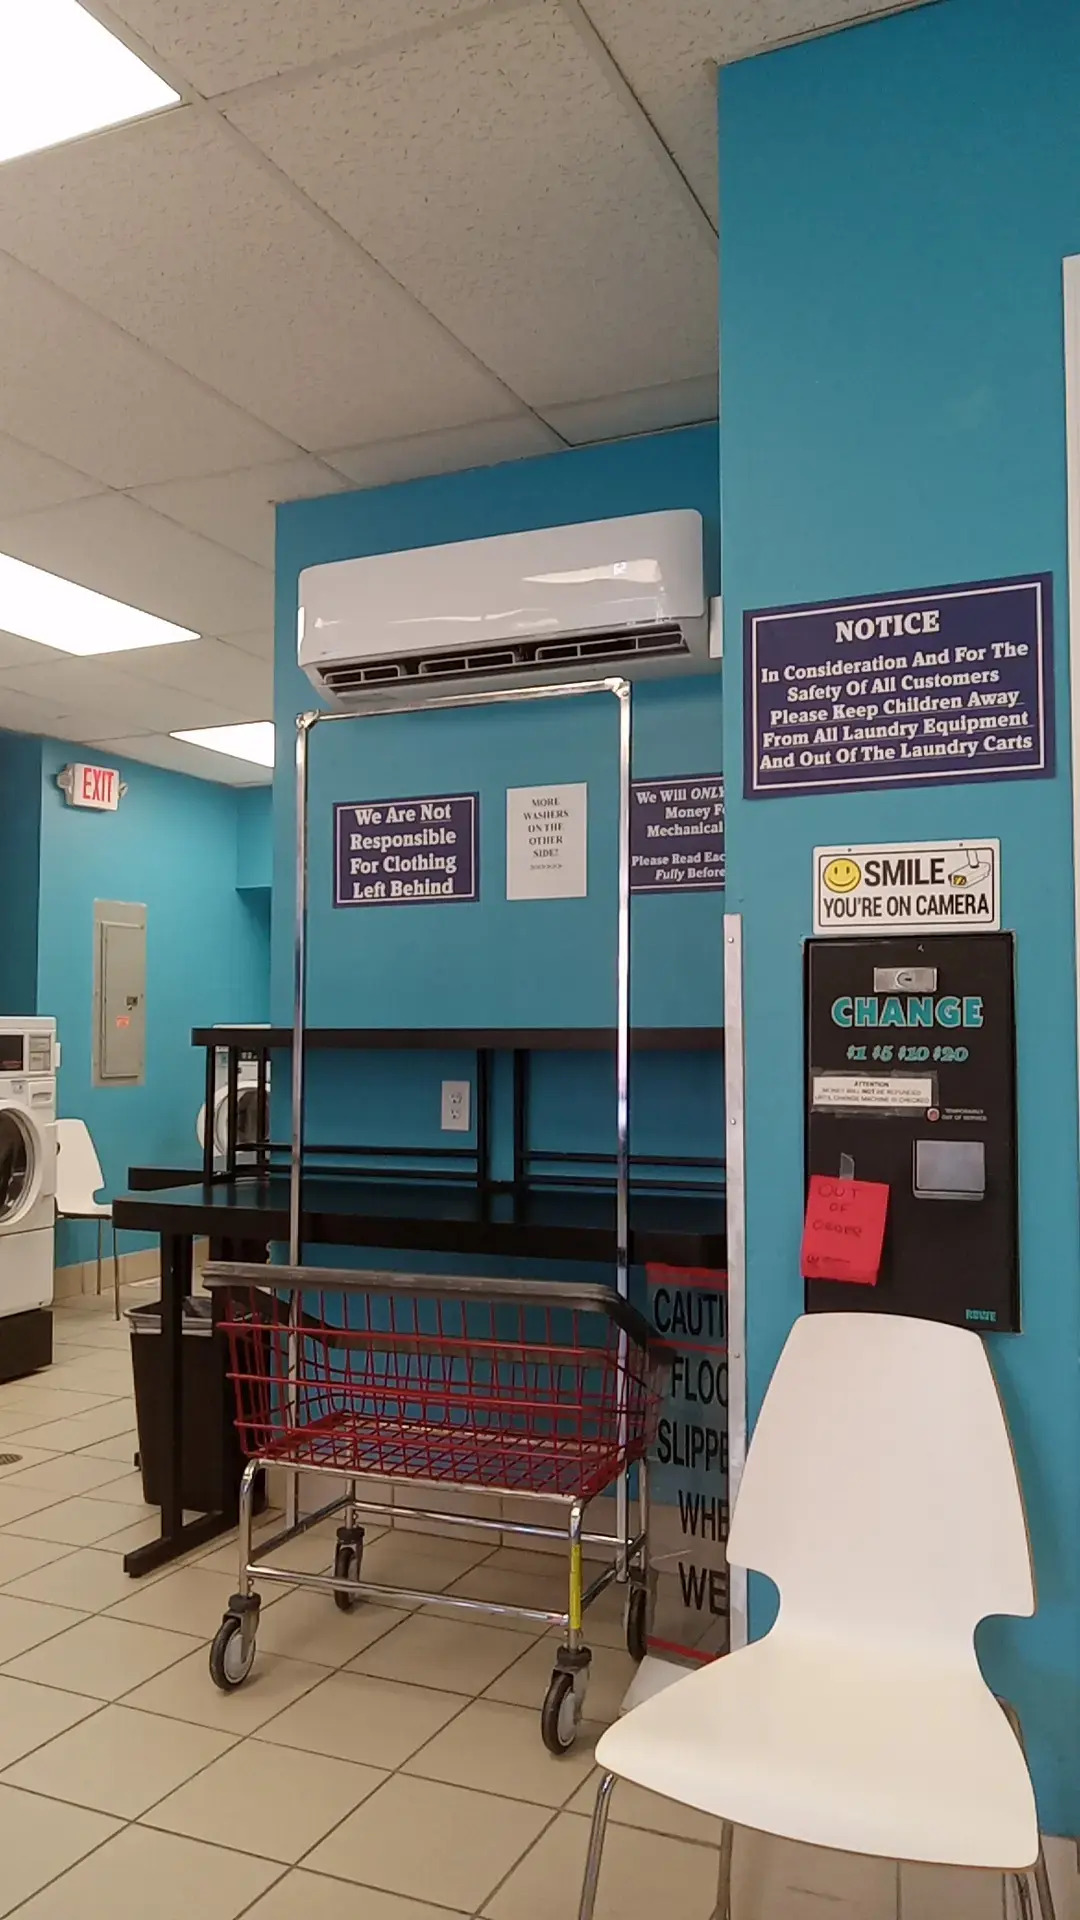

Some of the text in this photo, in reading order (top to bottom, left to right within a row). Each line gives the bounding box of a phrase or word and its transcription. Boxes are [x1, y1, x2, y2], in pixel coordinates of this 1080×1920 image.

[835, 609, 940, 643] NOTICE
[761, 641, 1029, 683] In Consideration And For The
[787, 669, 1000, 702] Safety Of All Customers
[770, 690, 1020, 726] Please Keep Children Away
[762, 711, 1029, 748] From All Laundry Equipment
[759, 735, 1033, 770] And Out Of The Laundry Carts
[82, 767, 114, 803] EXIT
[636, 786, 725, 804] We Will ONLY
[532, 797, 560, 807] MORE
[665, 806, 711, 820] Money
[354, 803, 452, 826] We Are Not
[523, 809, 569, 821] WASHERS
[527, 822, 563, 833] ON THE
[646, 821, 724, 838] Mechanical
[349, 827, 457, 853] Responsible
[528, 835, 563, 846] OTHER
[349, 853, 457, 875] For Clothing
[631, 852, 726, 867] Please Read Eac
[655, 867, 726, 882] Fully Before
[864, 858, 946, 887] SMILE
[353, 877, 454, 899] Left Behind
[823, 893, 990, 918] YOU'RE ON CAMERA
[831, 996, 984, 1028] CHANGE
[846, 1044, 969, 1062] $1 $5 $10 $20
[818, 1183, 861, 1199] OUT
[829, 1202, 852, 1213] OF
[653, 1288, 725, 1339] CAUTI
[678, 1489, 728, 1544] WHE
